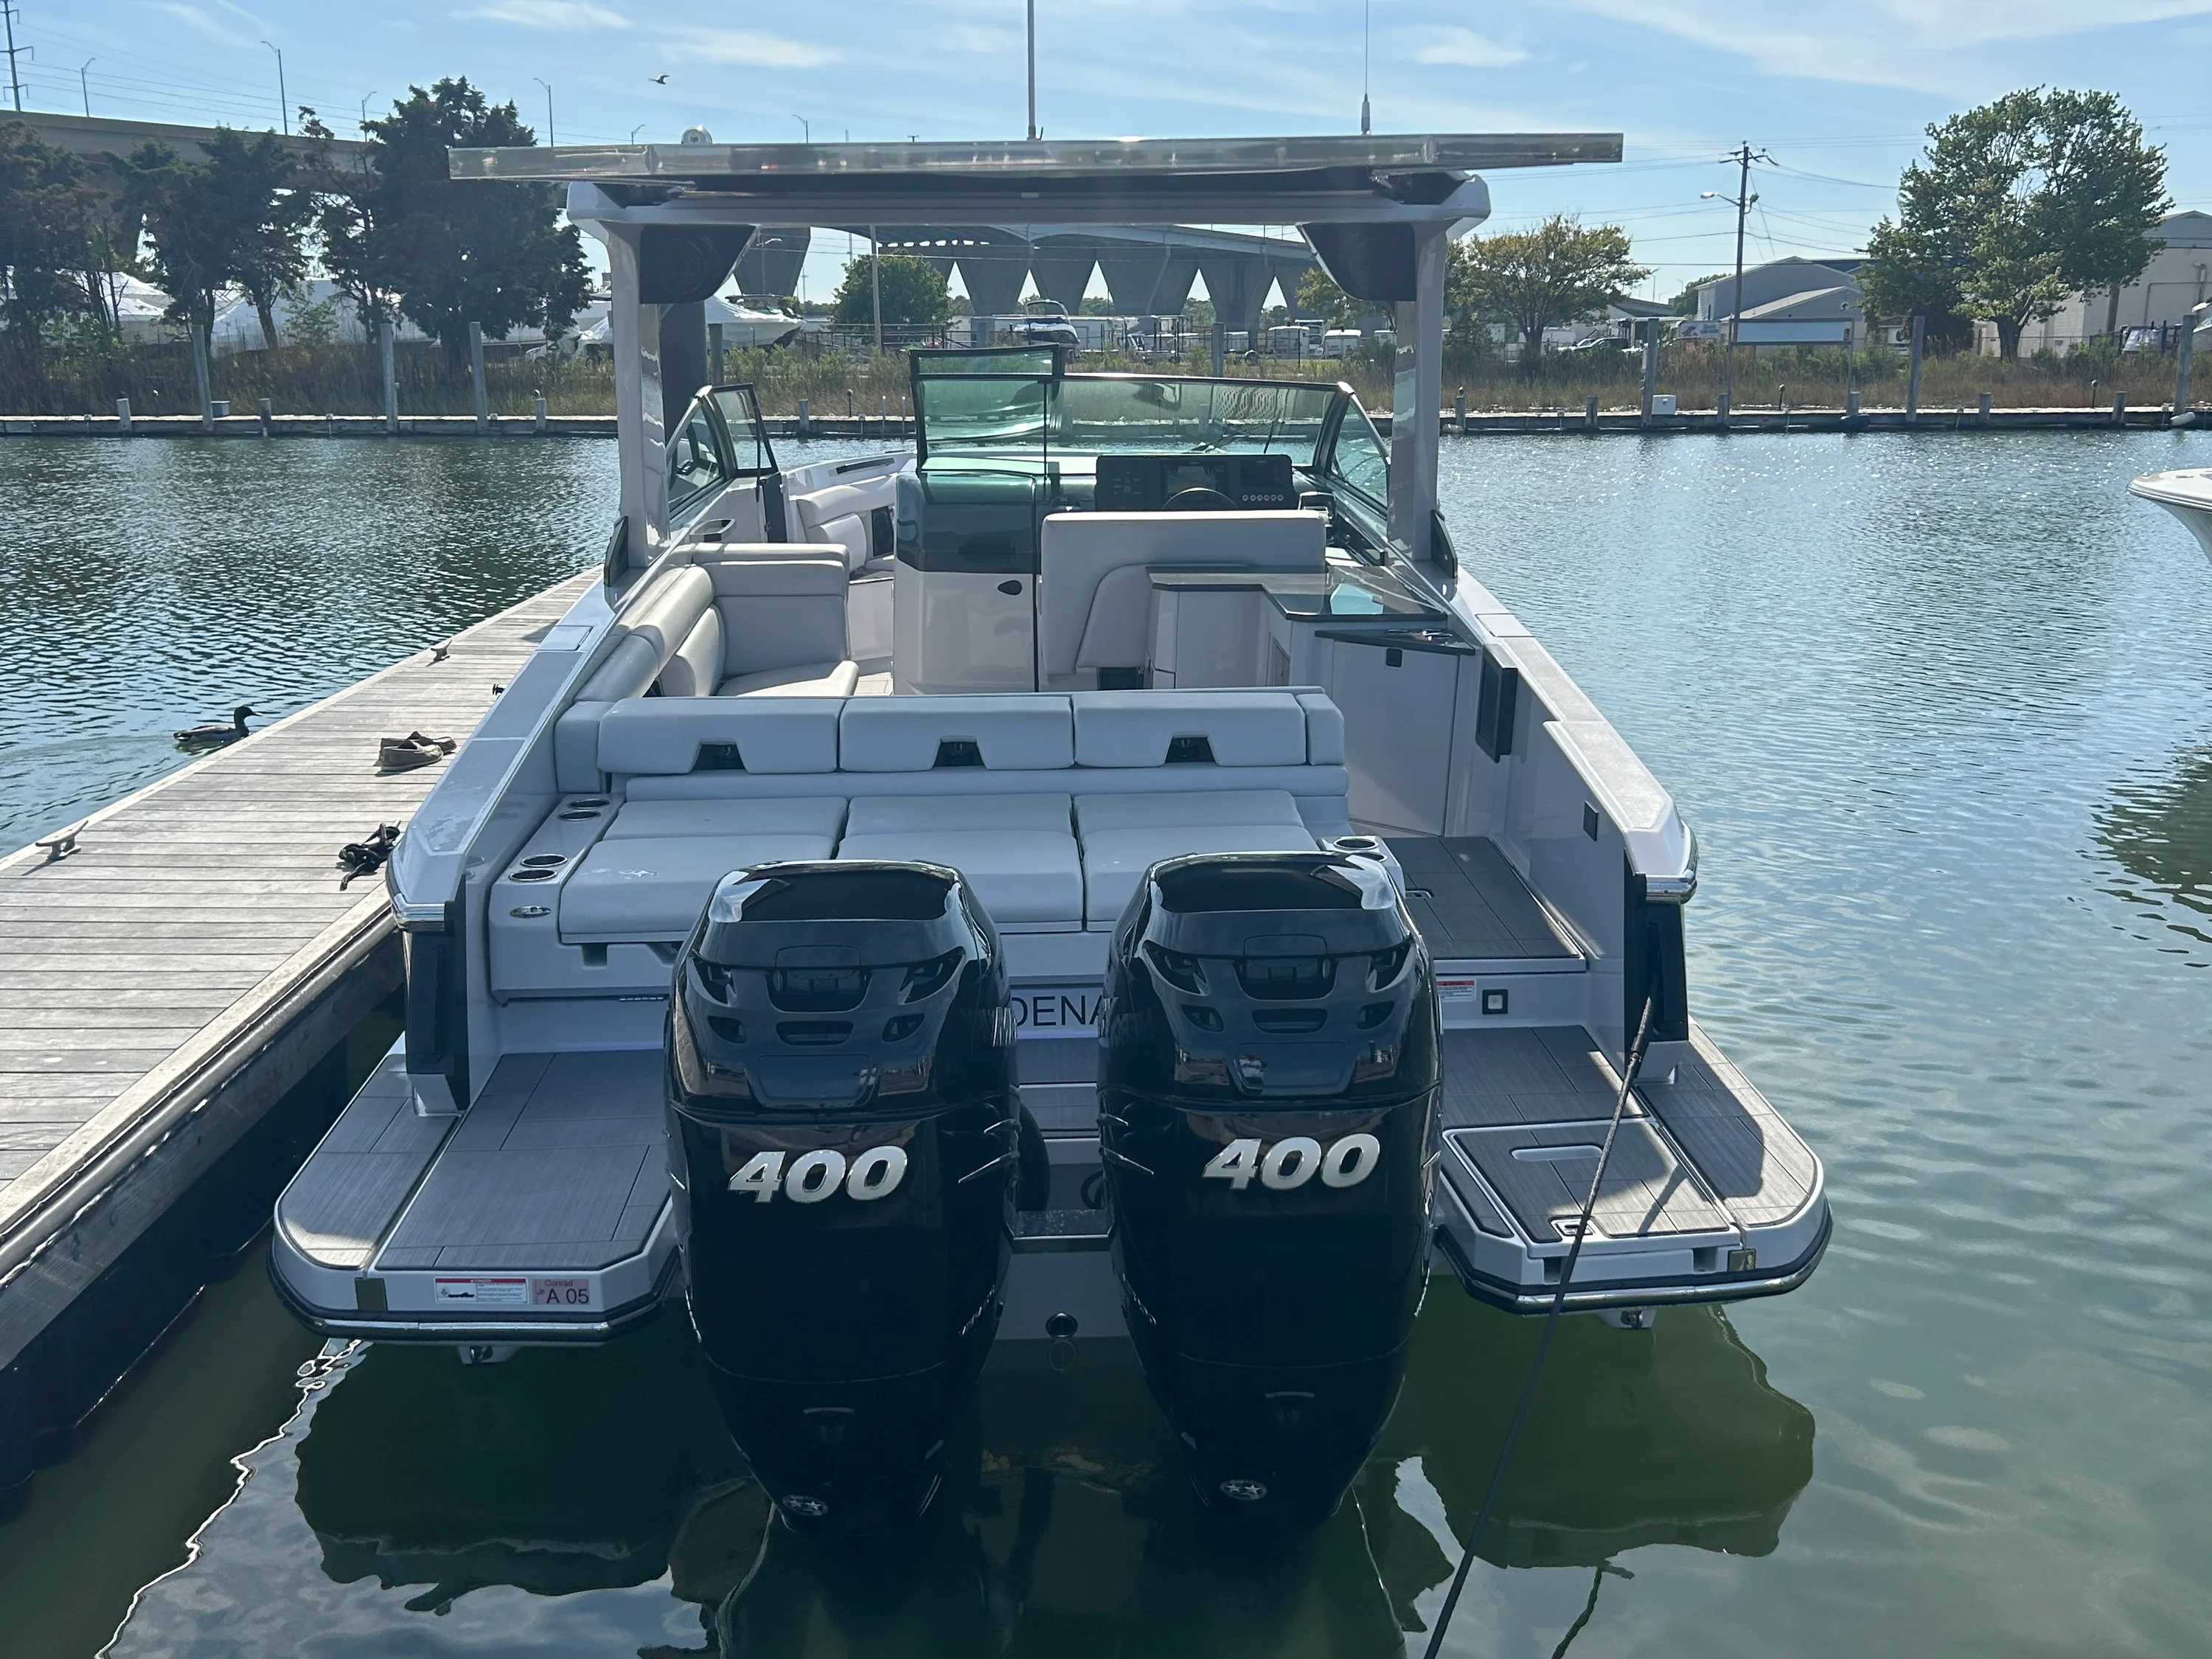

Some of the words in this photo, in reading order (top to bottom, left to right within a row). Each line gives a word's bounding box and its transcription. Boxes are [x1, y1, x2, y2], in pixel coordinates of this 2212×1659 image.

[727, 1145, 908, 1204] 400
[1201, 1133, 1381, 1190] 400
[546, 1288, 560, 1304] A
[566, 1288, 589, 1304] 05
